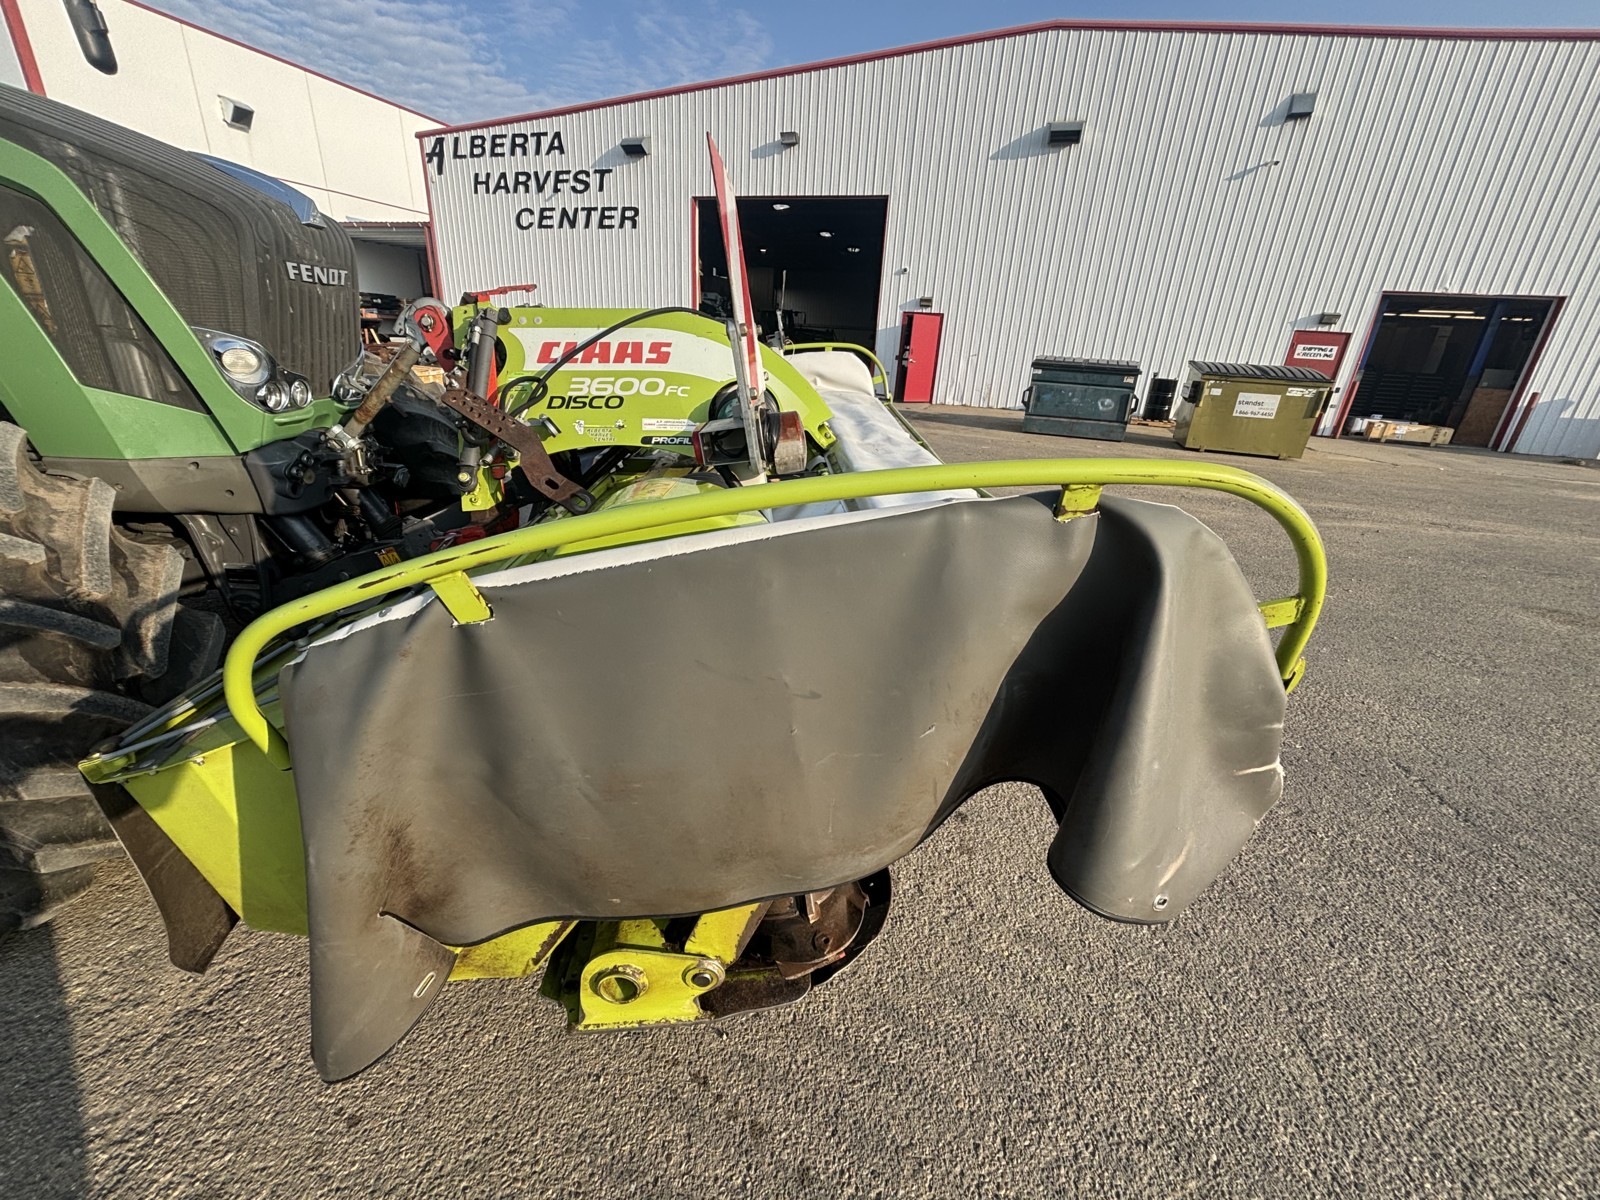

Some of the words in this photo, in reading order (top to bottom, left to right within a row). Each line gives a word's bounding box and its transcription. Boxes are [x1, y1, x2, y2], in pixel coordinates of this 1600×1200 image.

[426, 131, 566, 176] ALBERTA
[515, 206, 640, 230] CENTER
[285, 261, 348, 286] FENDT
[536, 341, 673, 364] CLAAS
[568, 377, 665, 396] 3600
[665, 386, 691, 397] FC
[546, 395, 625, 409] DISCO
